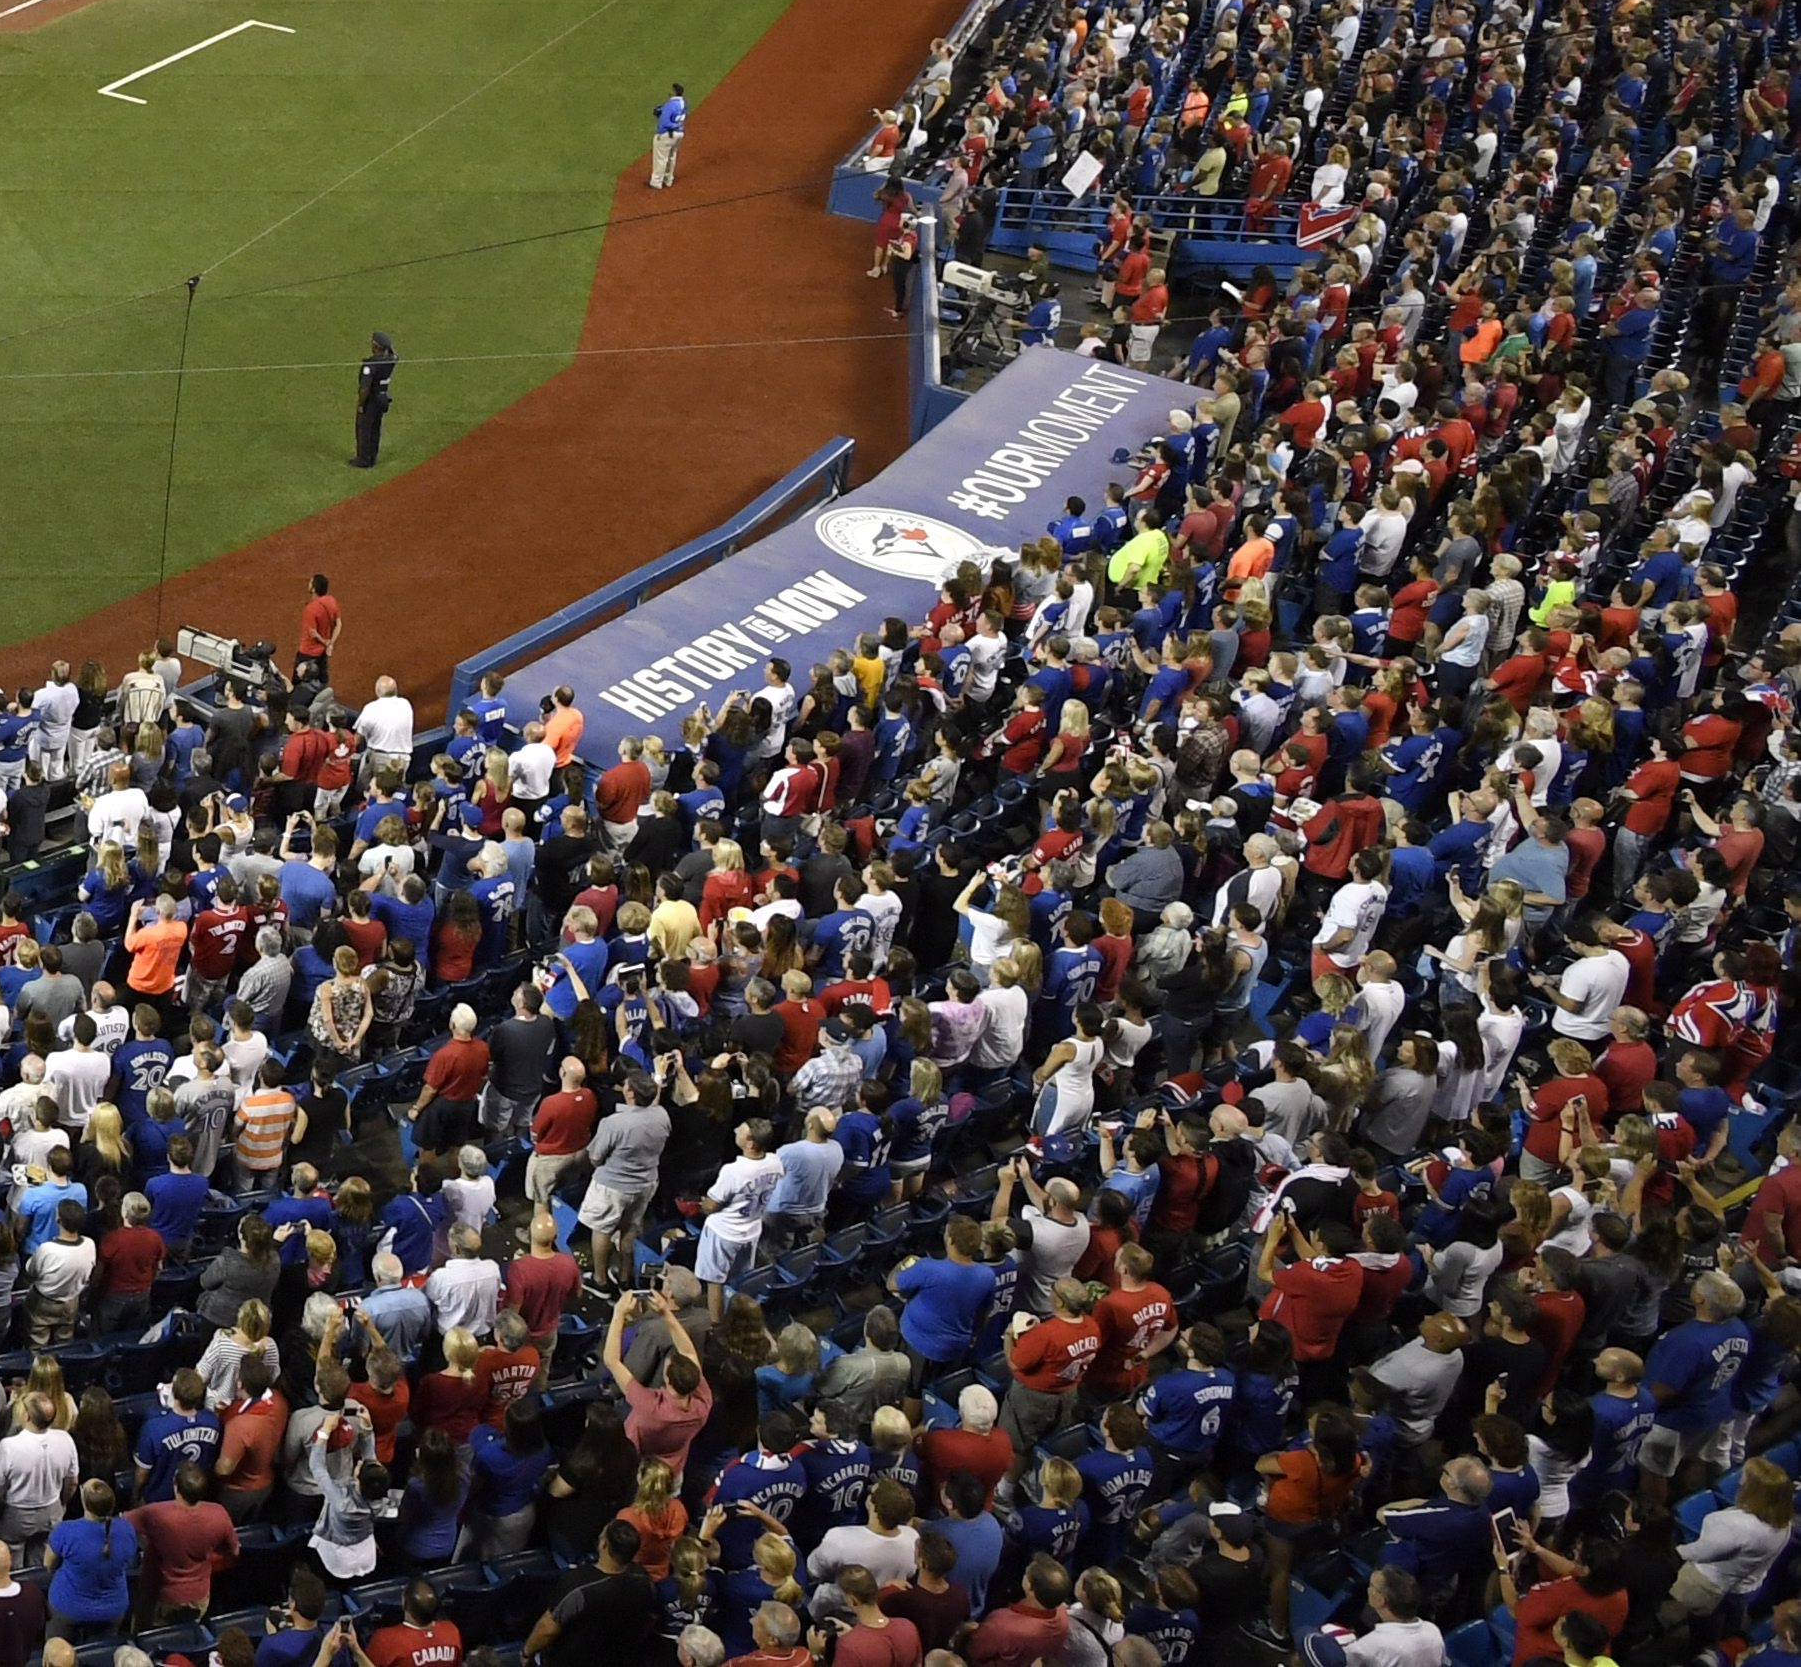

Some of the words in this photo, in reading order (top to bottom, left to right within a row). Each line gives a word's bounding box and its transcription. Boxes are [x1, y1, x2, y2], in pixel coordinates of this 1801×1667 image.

[946, 363, 1148, 520] #OURMOMENT
[754, 570, 868, 636] NOW
[740, 614, 792, 643] IS
[598, 622, 772, 724] HISTORY
[1132, 1303, 1167, 1327] DICKEY
[1200, 1405, 1221, 1436] 6
